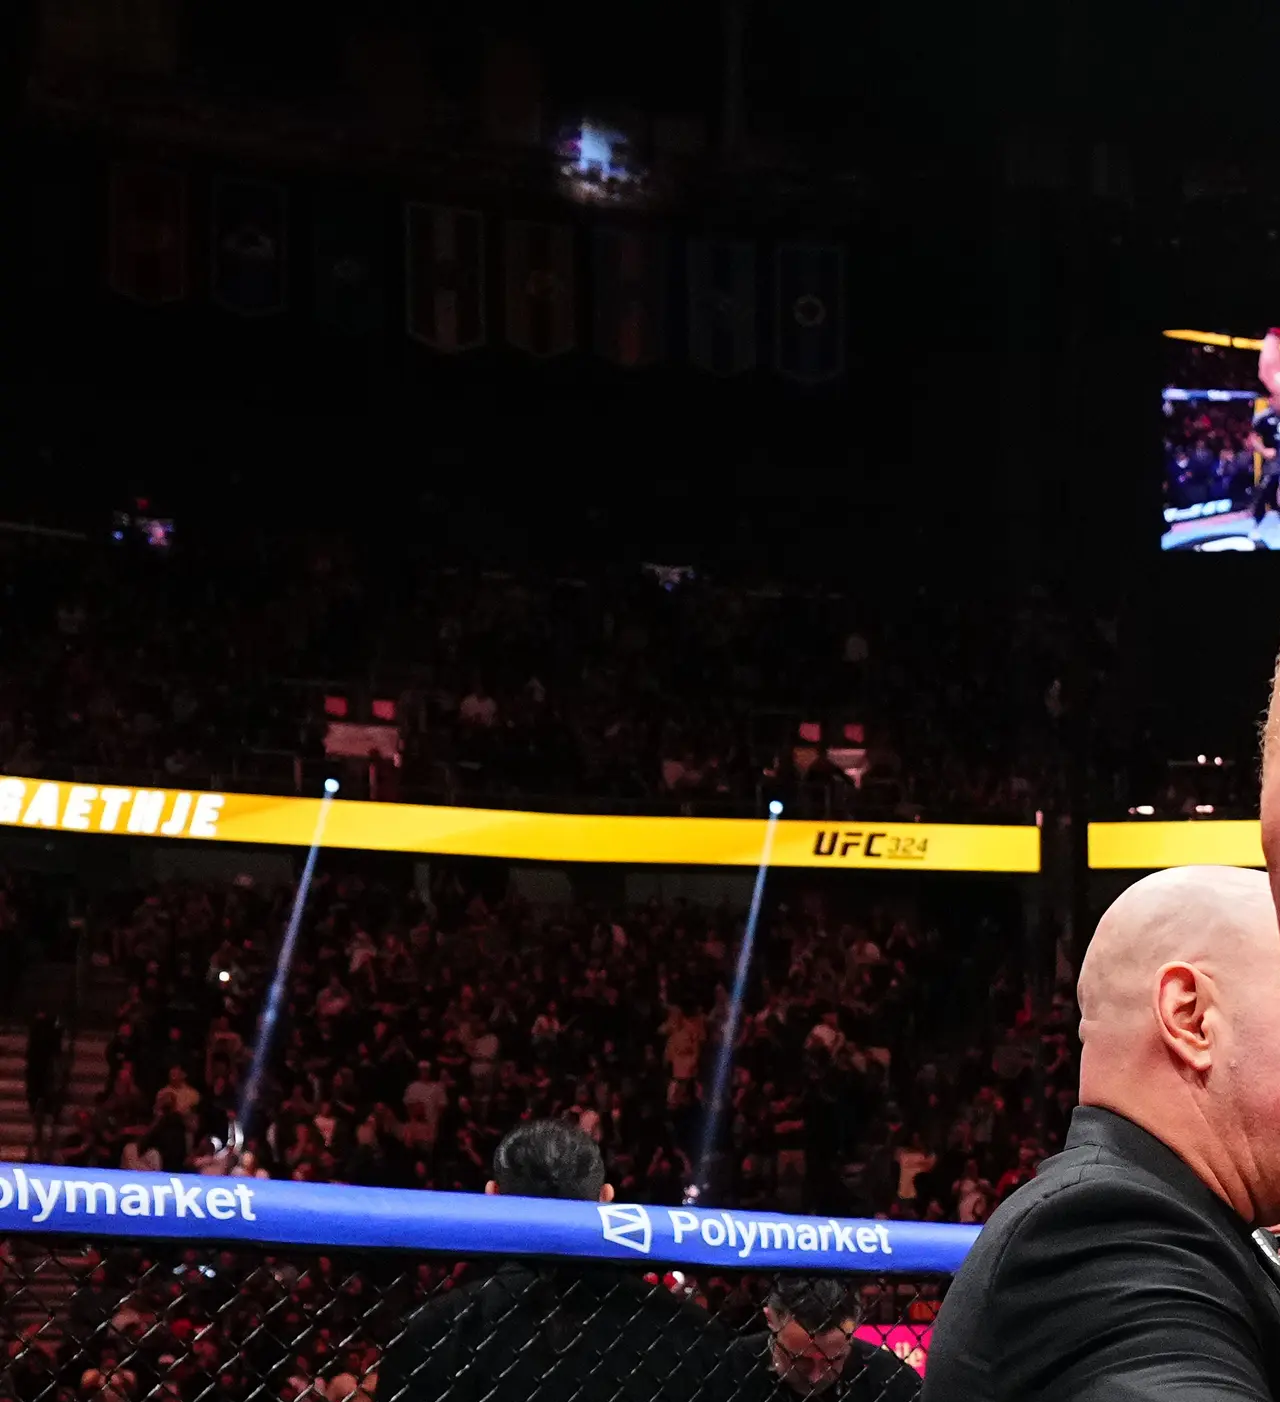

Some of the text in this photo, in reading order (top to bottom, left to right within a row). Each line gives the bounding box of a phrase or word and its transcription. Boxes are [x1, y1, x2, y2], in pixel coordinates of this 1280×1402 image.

[812, 830, 929, 858] UFC 324
[671, 1208, 892, 1258] Polymarket
